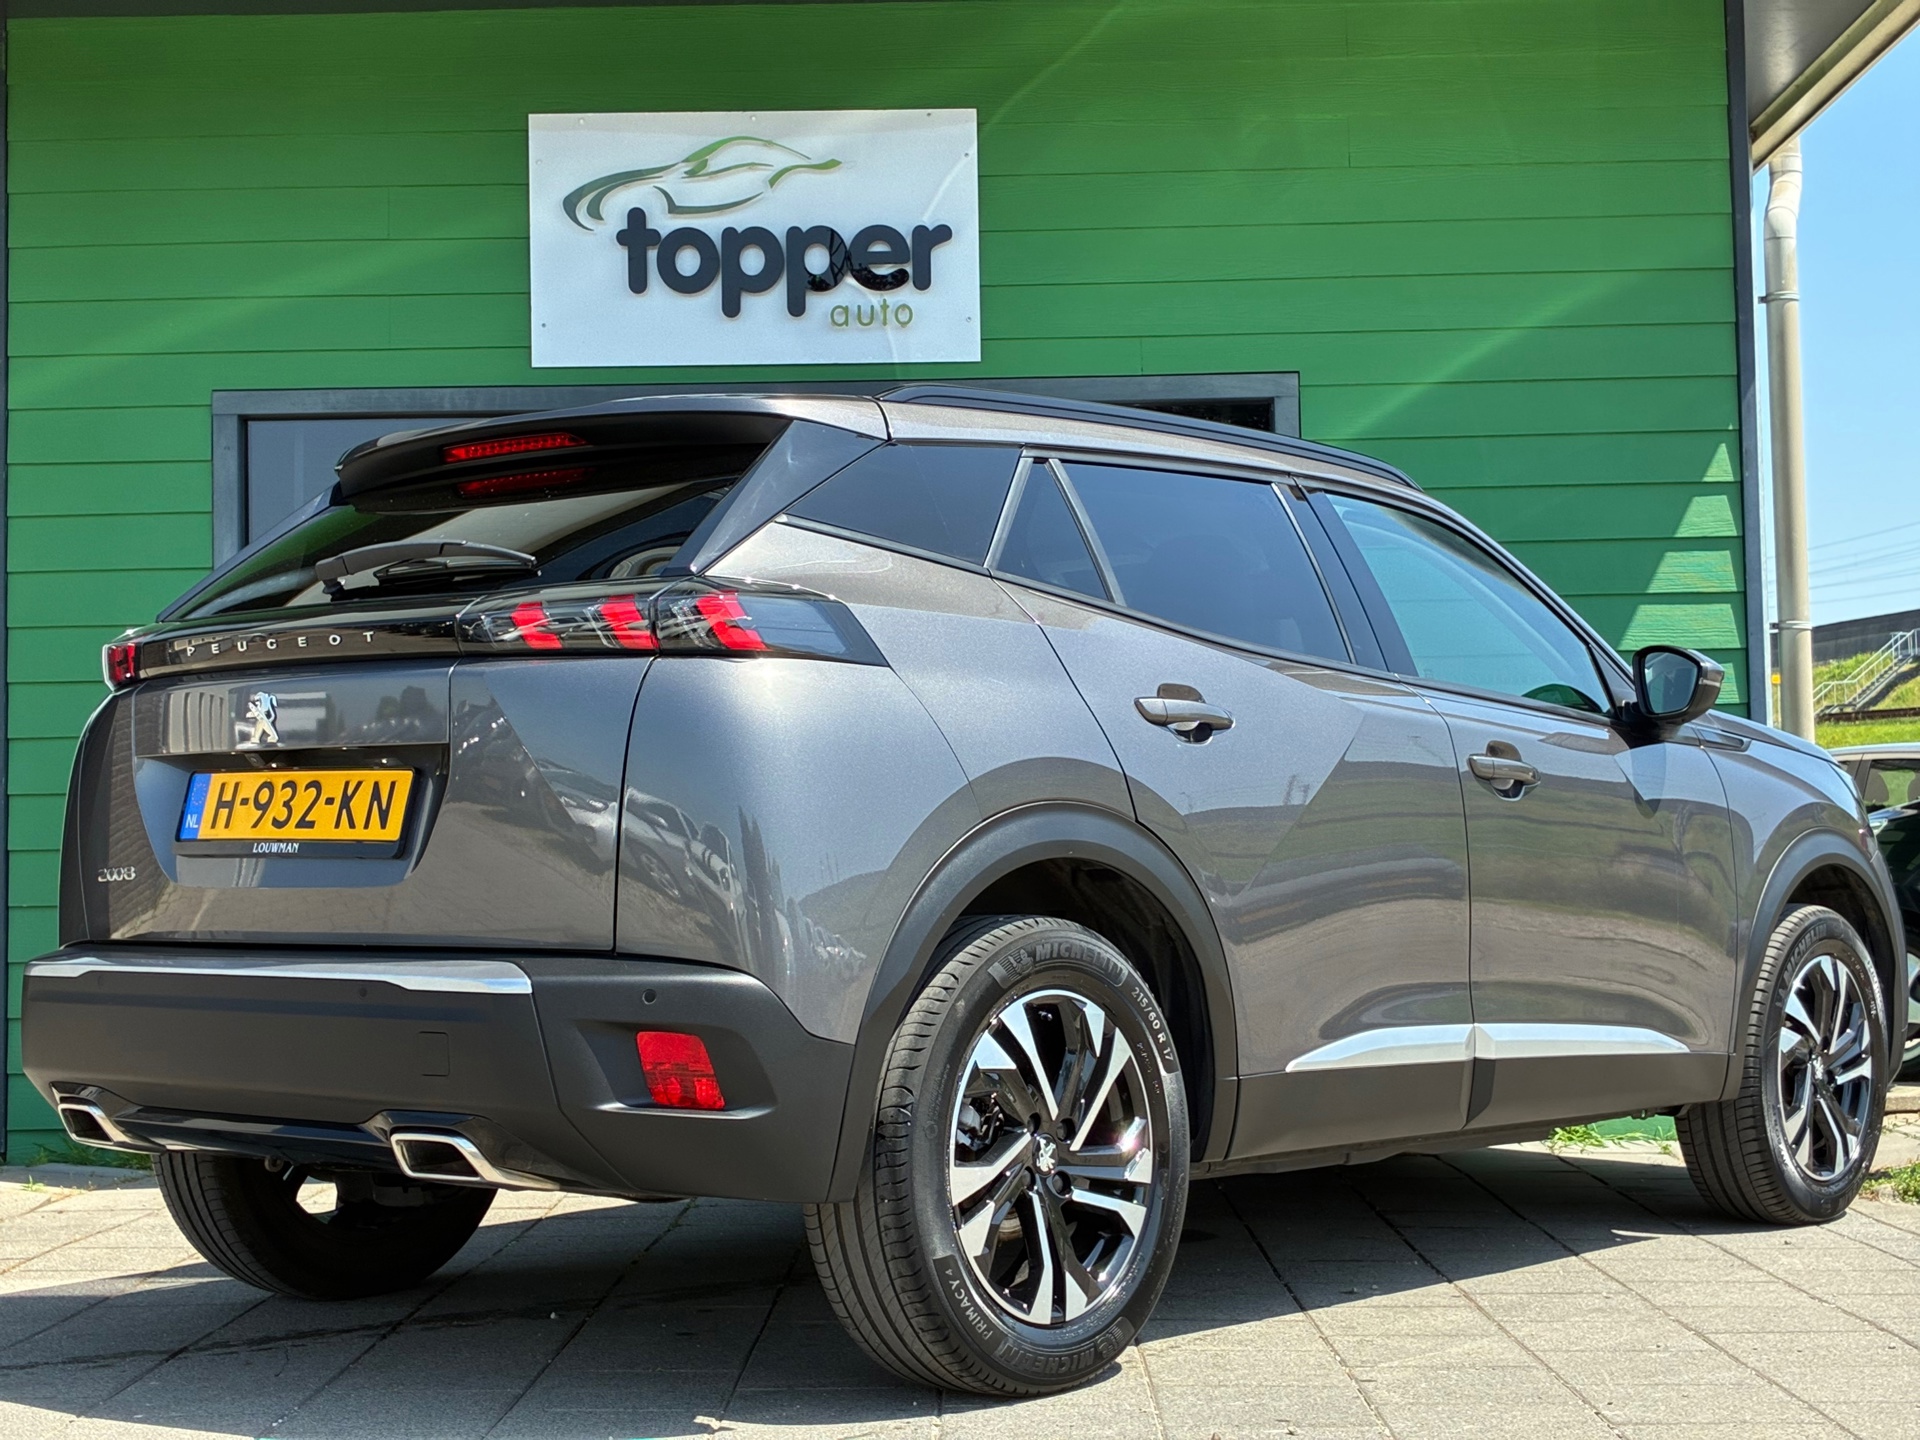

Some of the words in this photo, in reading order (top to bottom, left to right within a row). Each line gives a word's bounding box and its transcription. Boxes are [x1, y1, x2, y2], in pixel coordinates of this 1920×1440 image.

[616, 207, 953, 318] topper
[830, 298, 914, 327] auto
[186, 631, 374, 656] PEUGEOT
[185, 813, 199, 828] NL
[210, 780, 398, 830] H-932-KN
[252, 842, 299, 854] LOUWMAN
[98, 866, 136, 882] 2008
[1035, 941, 1124, 980] MICHELIN
[1783, 923, 1827, 989] MICHELIN
[1131, 986, 1161, 1030] 215/60
[1157, 1033, 1167, 1044] R
[1162, 1047, 1174, 1061] 17
[948, 1279, 994, 1341] PRIMACY
[995, 1336, 1096, 1374] MICHELIN
